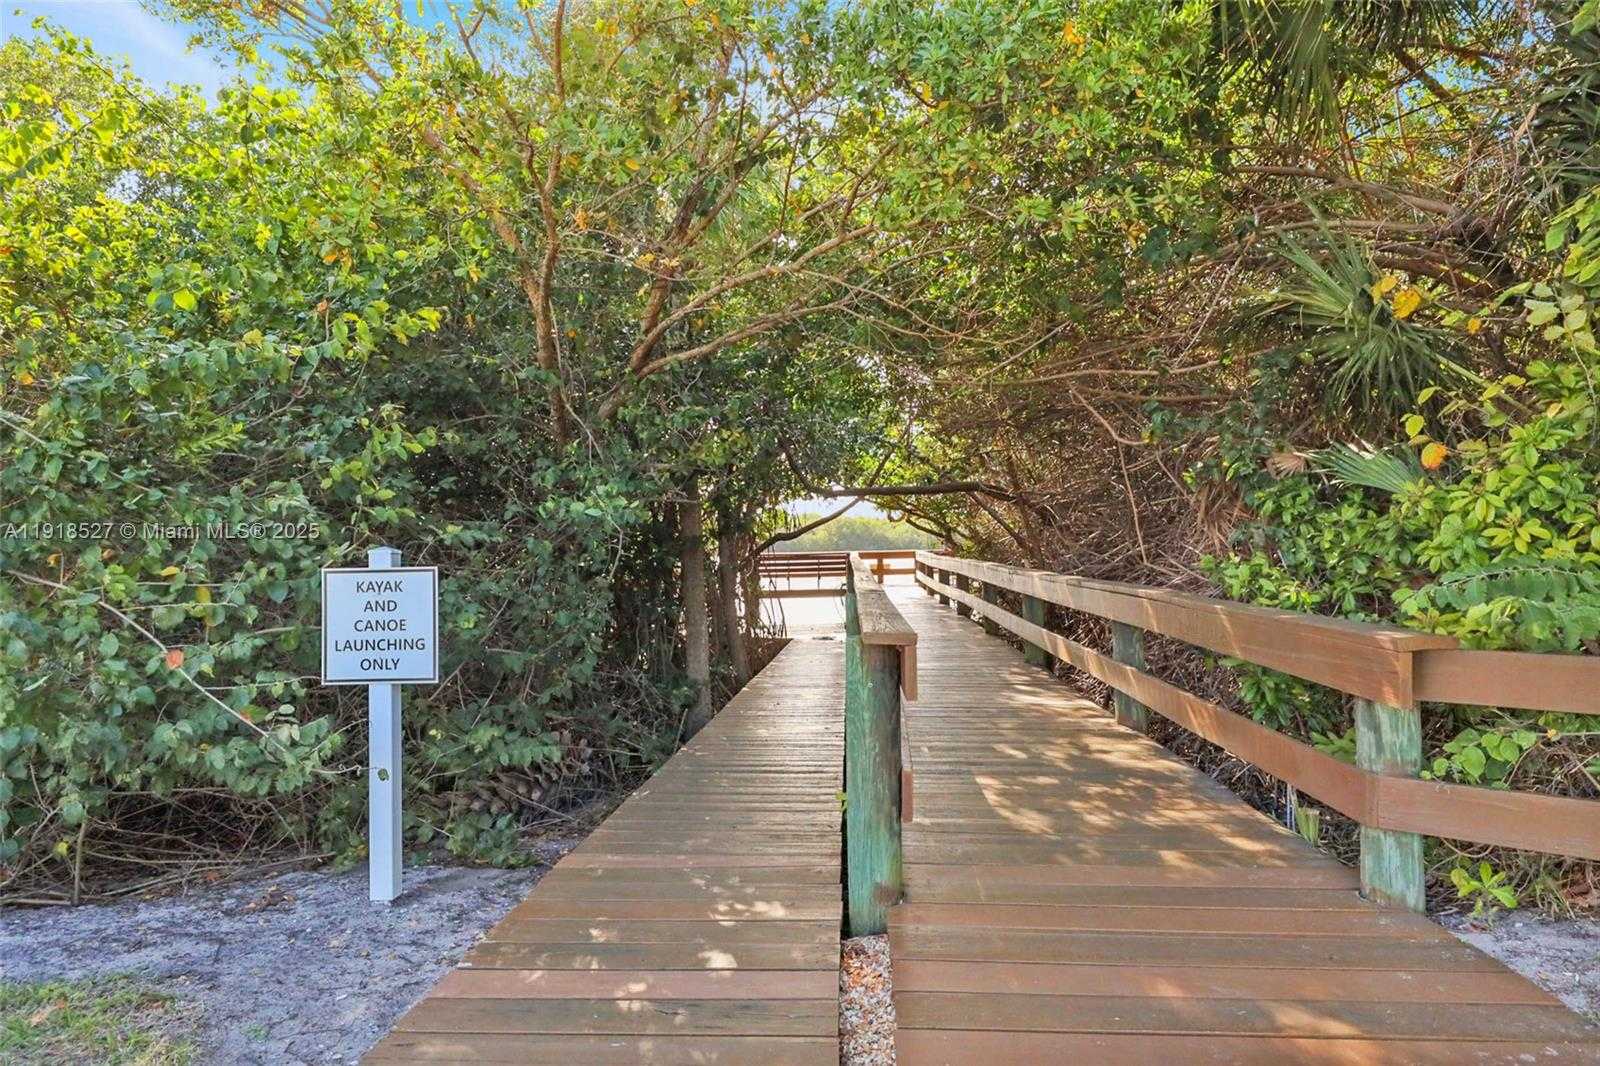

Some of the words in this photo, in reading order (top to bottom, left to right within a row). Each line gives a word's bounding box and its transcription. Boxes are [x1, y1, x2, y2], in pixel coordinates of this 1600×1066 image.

[356, 580, 403, 593] KAYAK
[364, 600, 397, 612] AND
[354, 619, 407, 632] CANOE
[335, 638, 426, 652] LAUNCHING
[360, 658, 400, 671] ONLY
